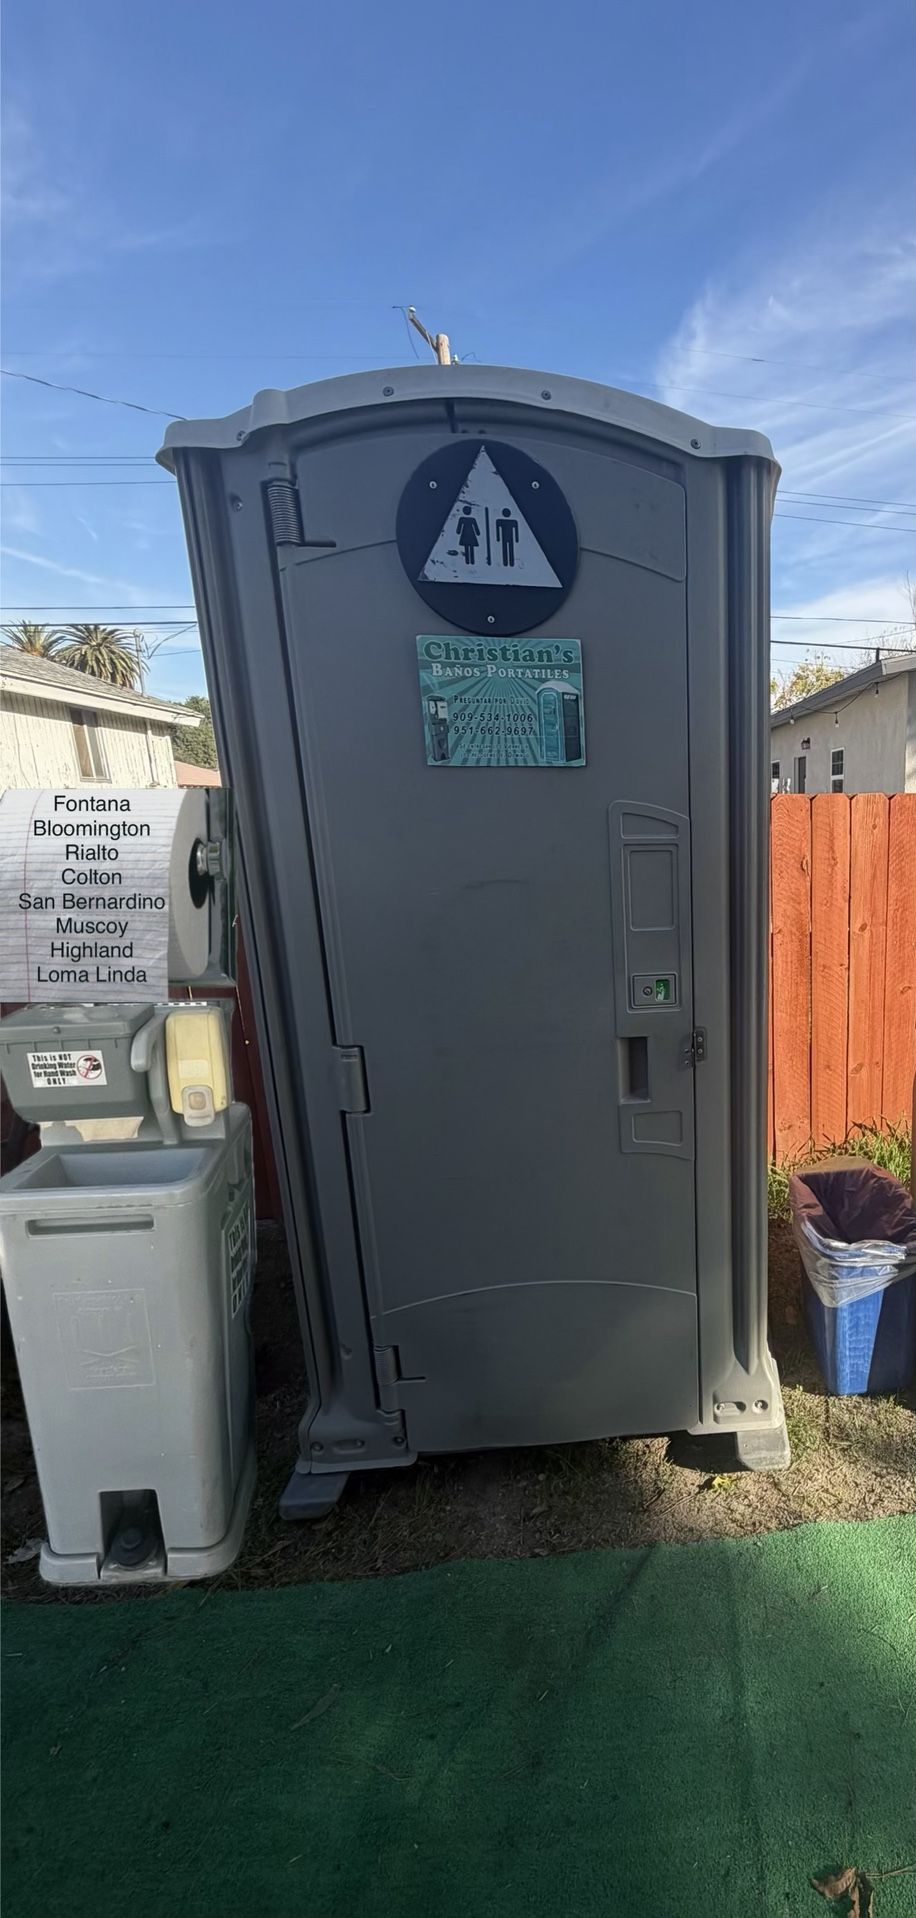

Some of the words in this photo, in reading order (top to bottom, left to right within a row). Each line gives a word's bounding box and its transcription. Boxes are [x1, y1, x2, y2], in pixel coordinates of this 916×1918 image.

[423, 640, 575, 665] Christian's
[431, 663, 480, 677] BAÑOS
[487, 665, 569, 679] PORTATILES
[452, 713, 534, 722] 909-534-1006
[453, 726, 534, 735] 951-662-9697
